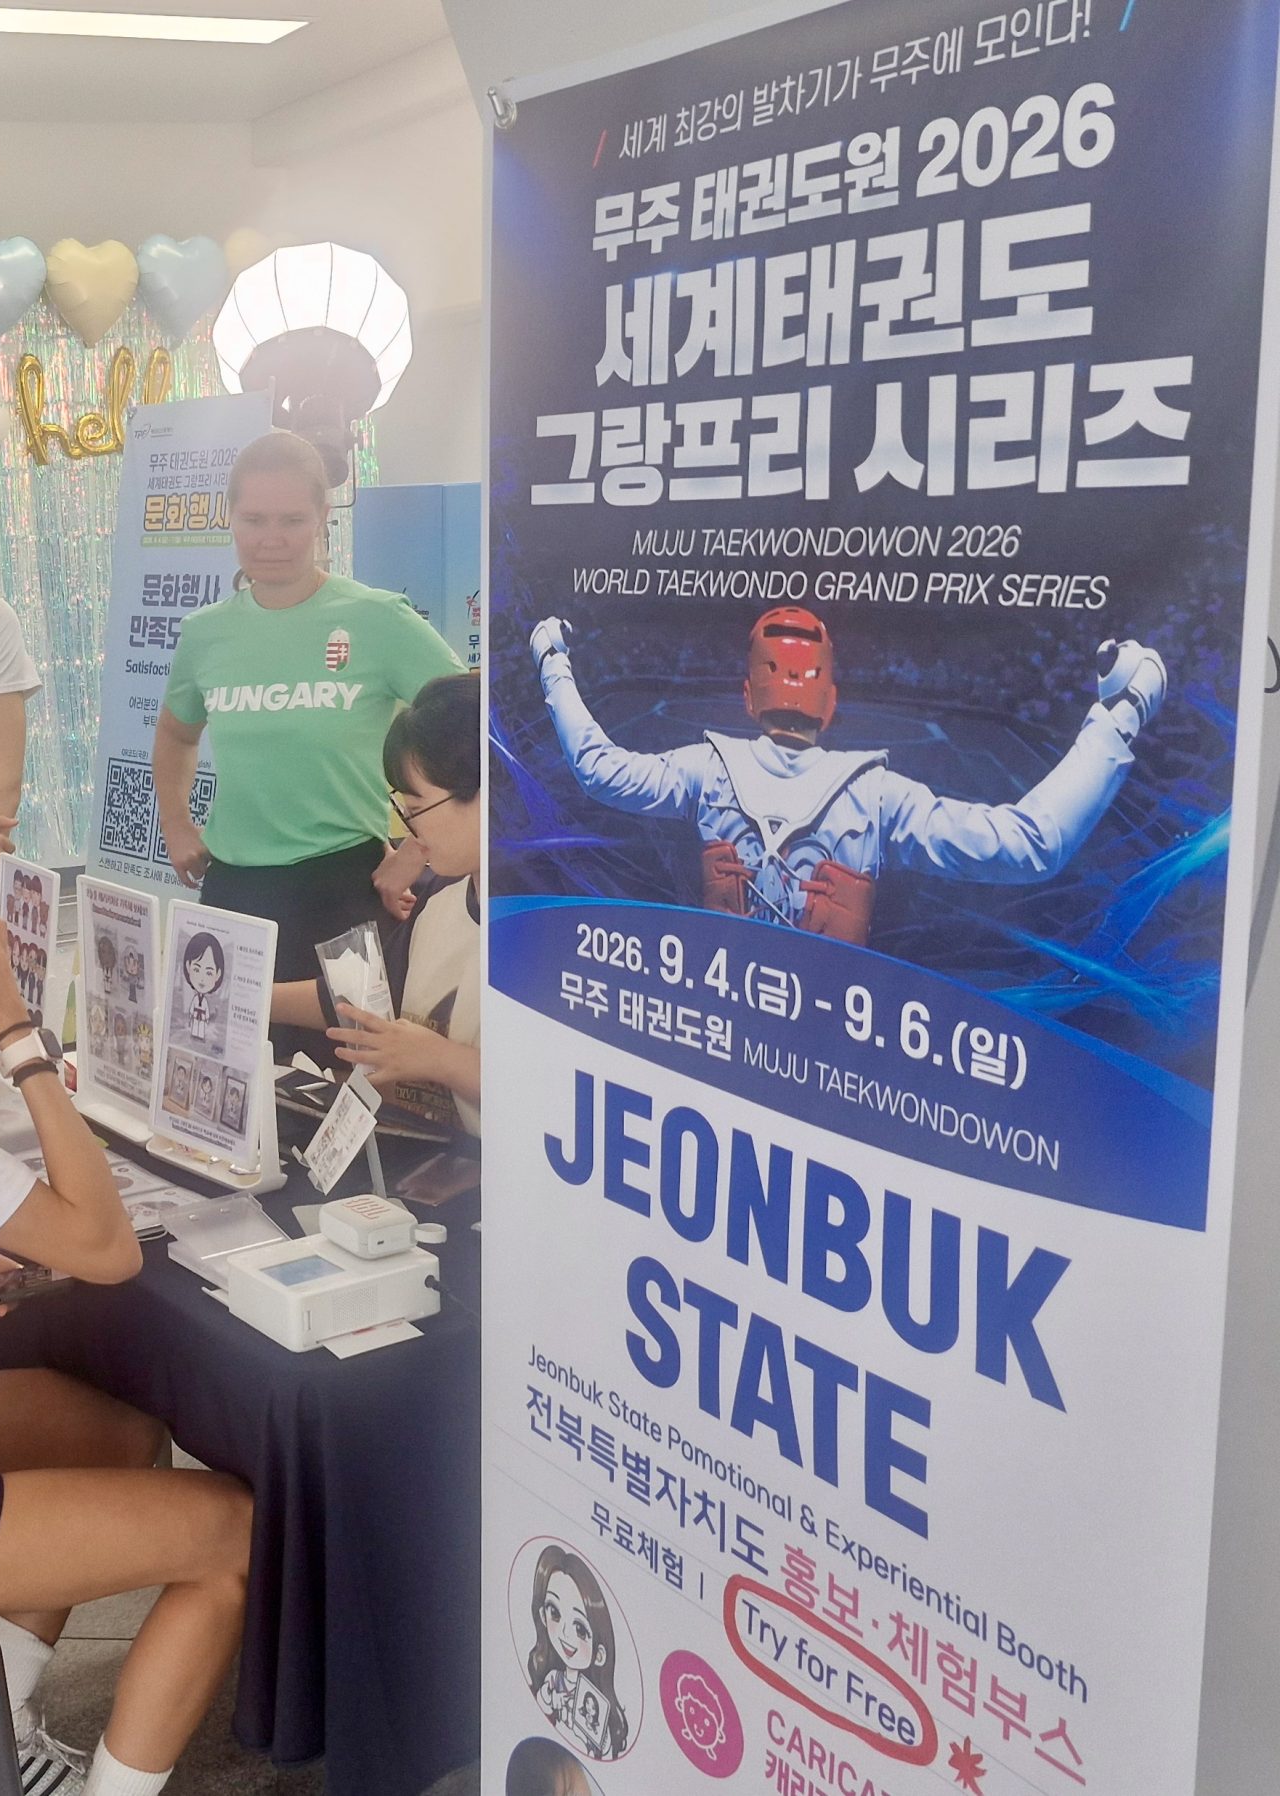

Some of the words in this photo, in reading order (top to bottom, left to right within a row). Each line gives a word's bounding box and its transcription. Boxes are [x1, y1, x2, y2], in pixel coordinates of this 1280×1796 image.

[617, 120, 668, 161] 세계
[674, 93, 744, 145] 최강의
[751, 55, 863, 129] 발차기가
[869, 27, 964, 92] 무주에
[973, 0, 1092, 66] 모인다!
[592, 181, 682, 264] 무주
[690, 126, 902, 242] 태권도원
[915, 81, 1116, 198] 2026
[594, 202, 1094, 389] 세계태권도
[149, 452, 169, 473] 무주
[169, 449, 209, 471] 태권도원
[530, 391, 832, 508] 그랑프리
[852, 355, 1194, 498] 시리즈
[143, 491, 232, 532] 문화행사
[631, 528, 697, 556] MUJU
[699, 526, 943, 557] TAEKWONDOWON
[947, 524, 1022, 558] 2026
[141, 572, 221, 608] 문화행사
[572, 568, 652, 595] WORLD
[654, 569, 810, 599] TAEKWONDO
[813, 571, 919, 602] GRAND
[924, 573, 996, 605] PRIX
[994, 574, 1111, 609] SERIES
[205, 681, 363, 712] HUNGARY
[575, 922, 651, 976] 2026.
[658, 934, 695, 986] 9.
[844, 983, 884, 1045] 9.
[558, 969, 610, 1019] 무주
[617, 986, 734, 1063] 태권도원
[742, 1037, 809, 1085] MUJU
[814, 1061, 1061, 1172] TAEKWONDOWON
[543, 1068, 1072, 1414] JEONBUK
[625, 1255, 932, 1541] STATE
[526, 1384, 770, 1578] 전북특별자치도
[527, 1343, 604, 1407] Jeonbuk
[608, 1388, 663, 1445] State
[667, 1419, 794, 1521] Pomotional
[799, 1501, 820, 1535] &
[824, 1515, 990, 1645] Experiential
[996, 1622, 1089, 1704] Booth
[590, 1499, 686, 1591] 무료체험
[741, 1597, 789, 1653] Try
[795, 1630, 839, 1692] for
[845, 1673, 917, 1746] Free
